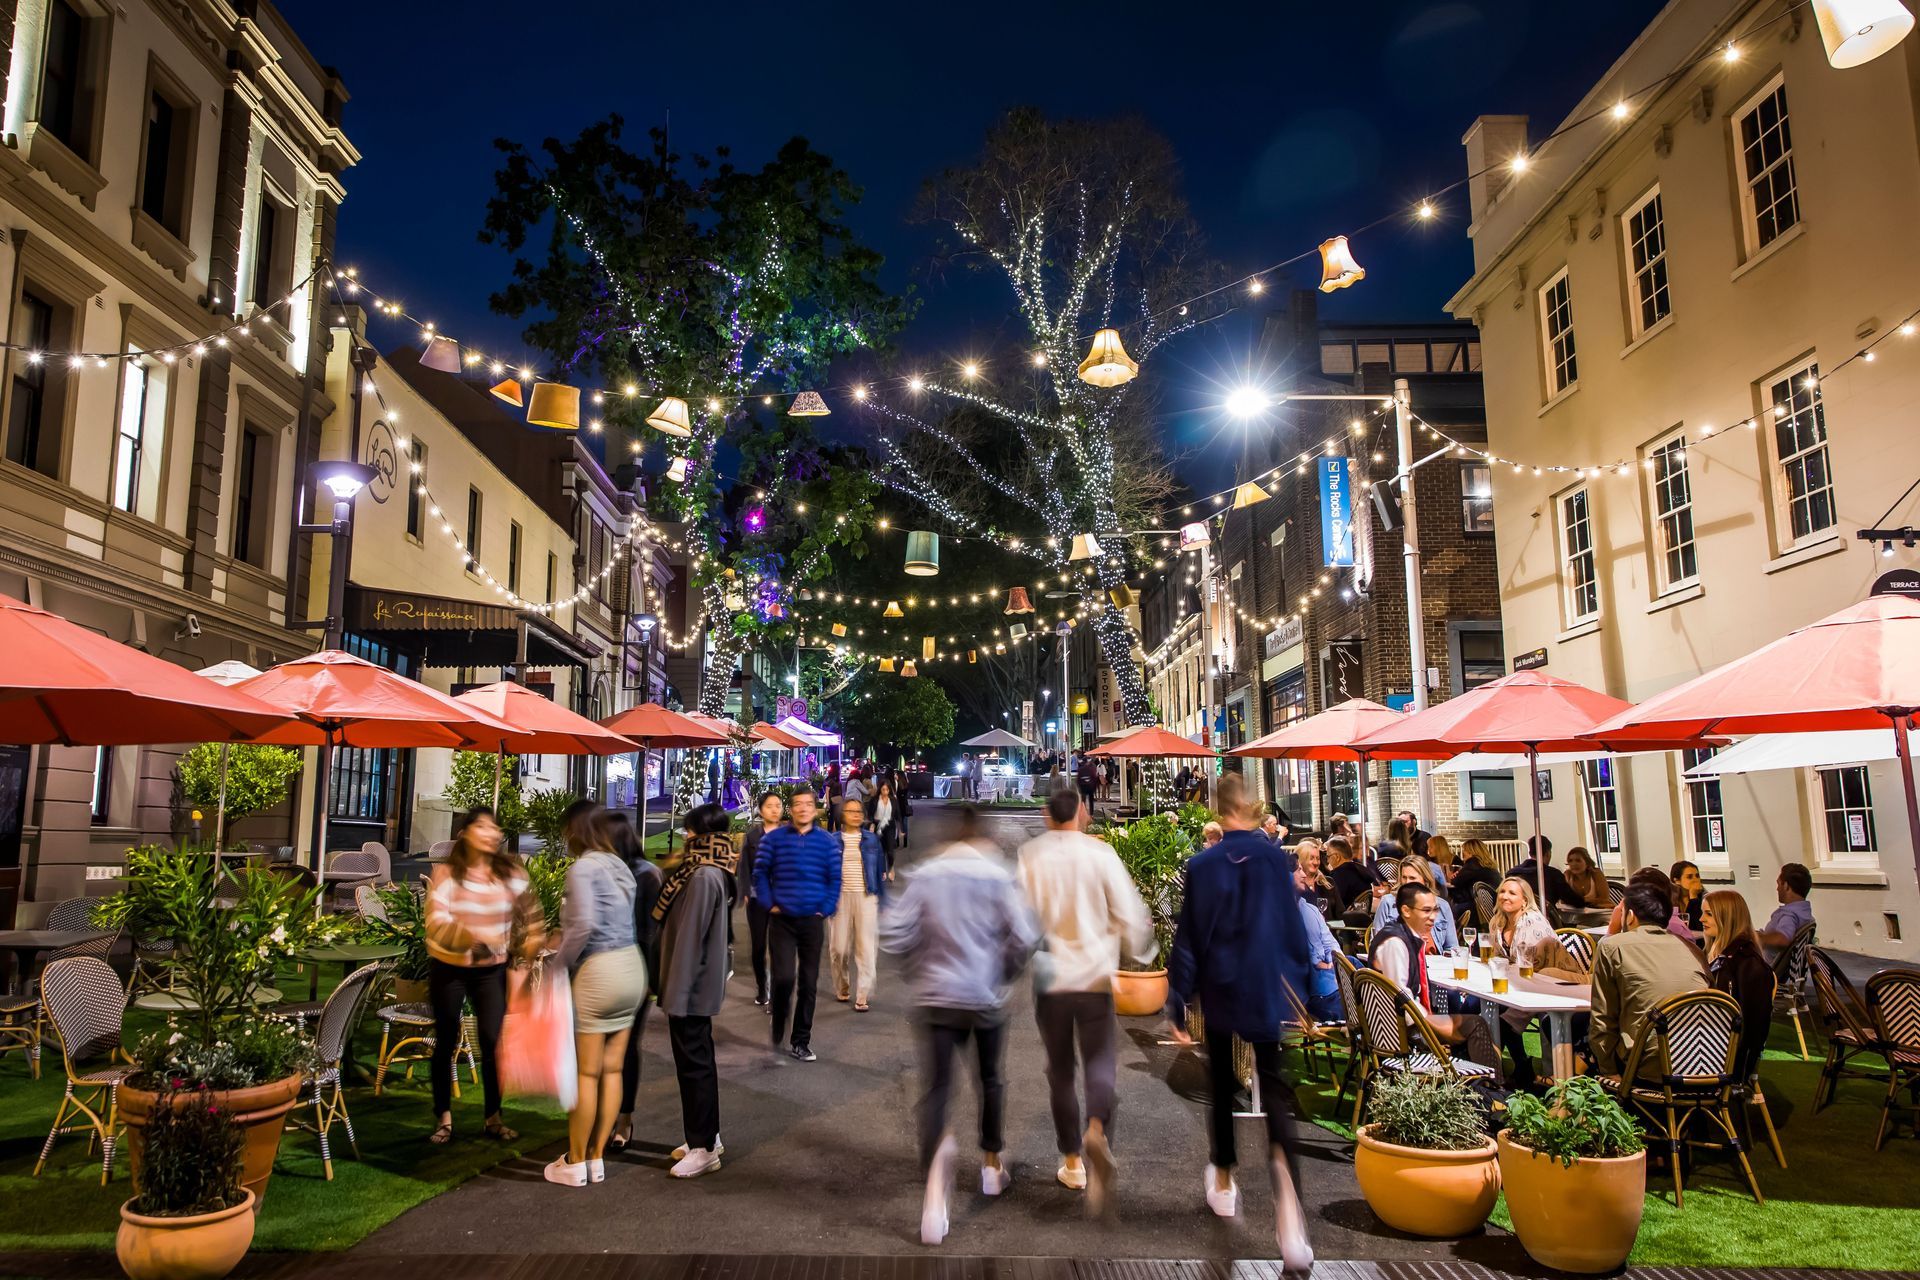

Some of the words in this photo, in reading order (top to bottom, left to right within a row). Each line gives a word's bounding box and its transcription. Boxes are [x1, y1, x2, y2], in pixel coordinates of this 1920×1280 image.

[1329, 473, 1340, 490] The
[1330, 492, 1342, 518] Rocks
[374, 600, 392, 621] La
[393, 601, 476, 621] Renaissance
[1336, 646, 1359, 700] pony
